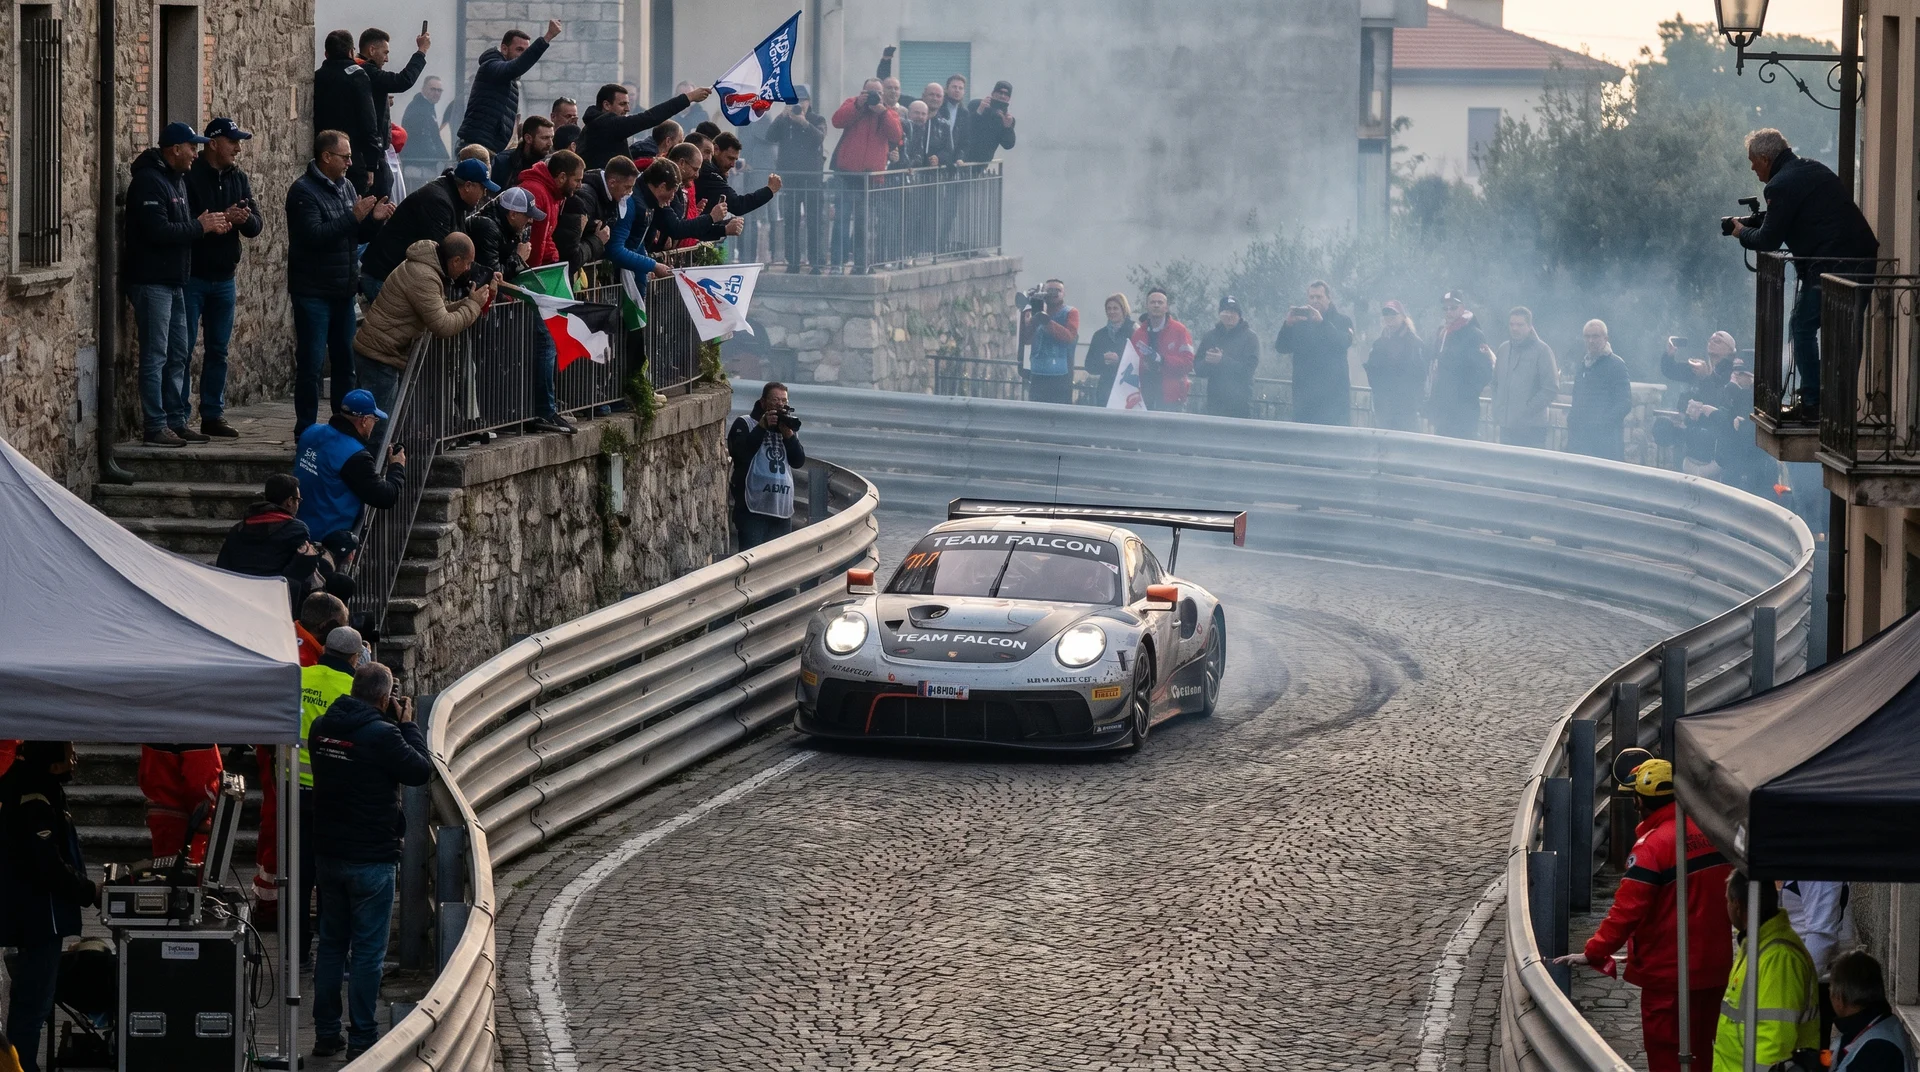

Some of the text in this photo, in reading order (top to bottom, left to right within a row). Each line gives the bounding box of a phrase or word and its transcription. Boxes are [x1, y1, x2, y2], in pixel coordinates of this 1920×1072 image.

[934, 535, 1101, 555] TEAM FALCON
[896, 634, 1027, 650] TEAM FALCON
